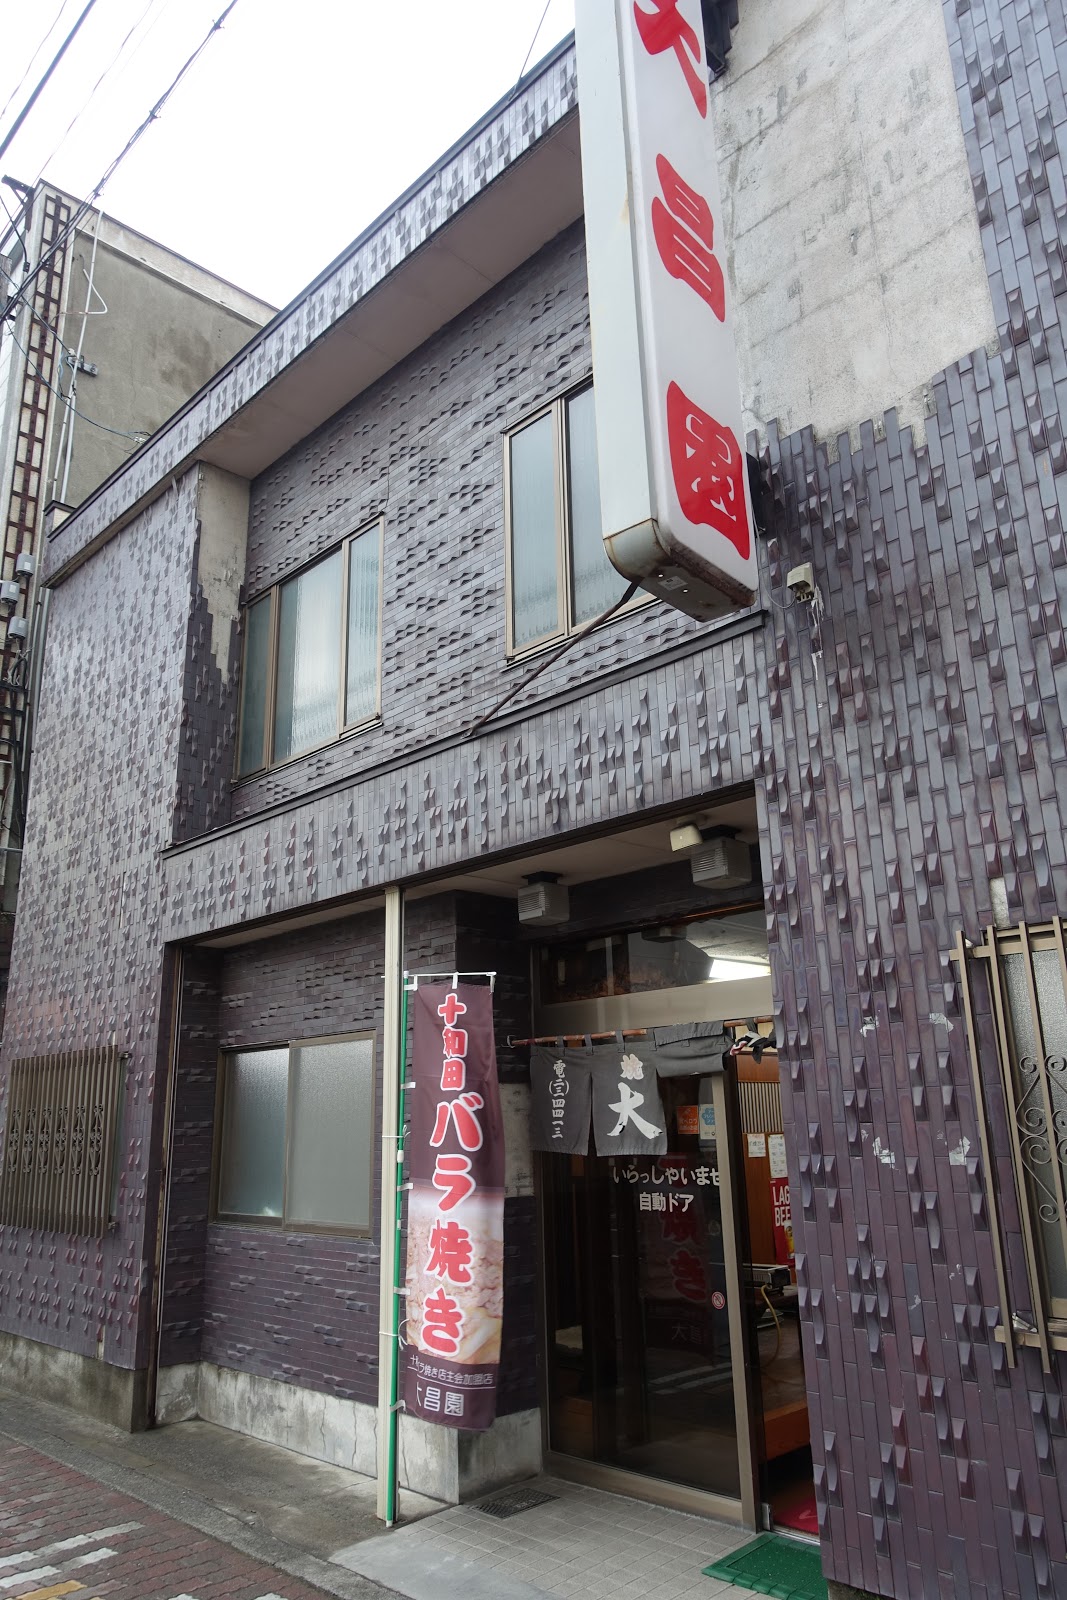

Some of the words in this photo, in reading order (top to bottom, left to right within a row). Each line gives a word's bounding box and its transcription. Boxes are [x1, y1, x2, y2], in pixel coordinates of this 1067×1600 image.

[421, 994, 484, 1356] 十和田バラ焼き
[640, 1192, 694, 1212] 自動ドア
